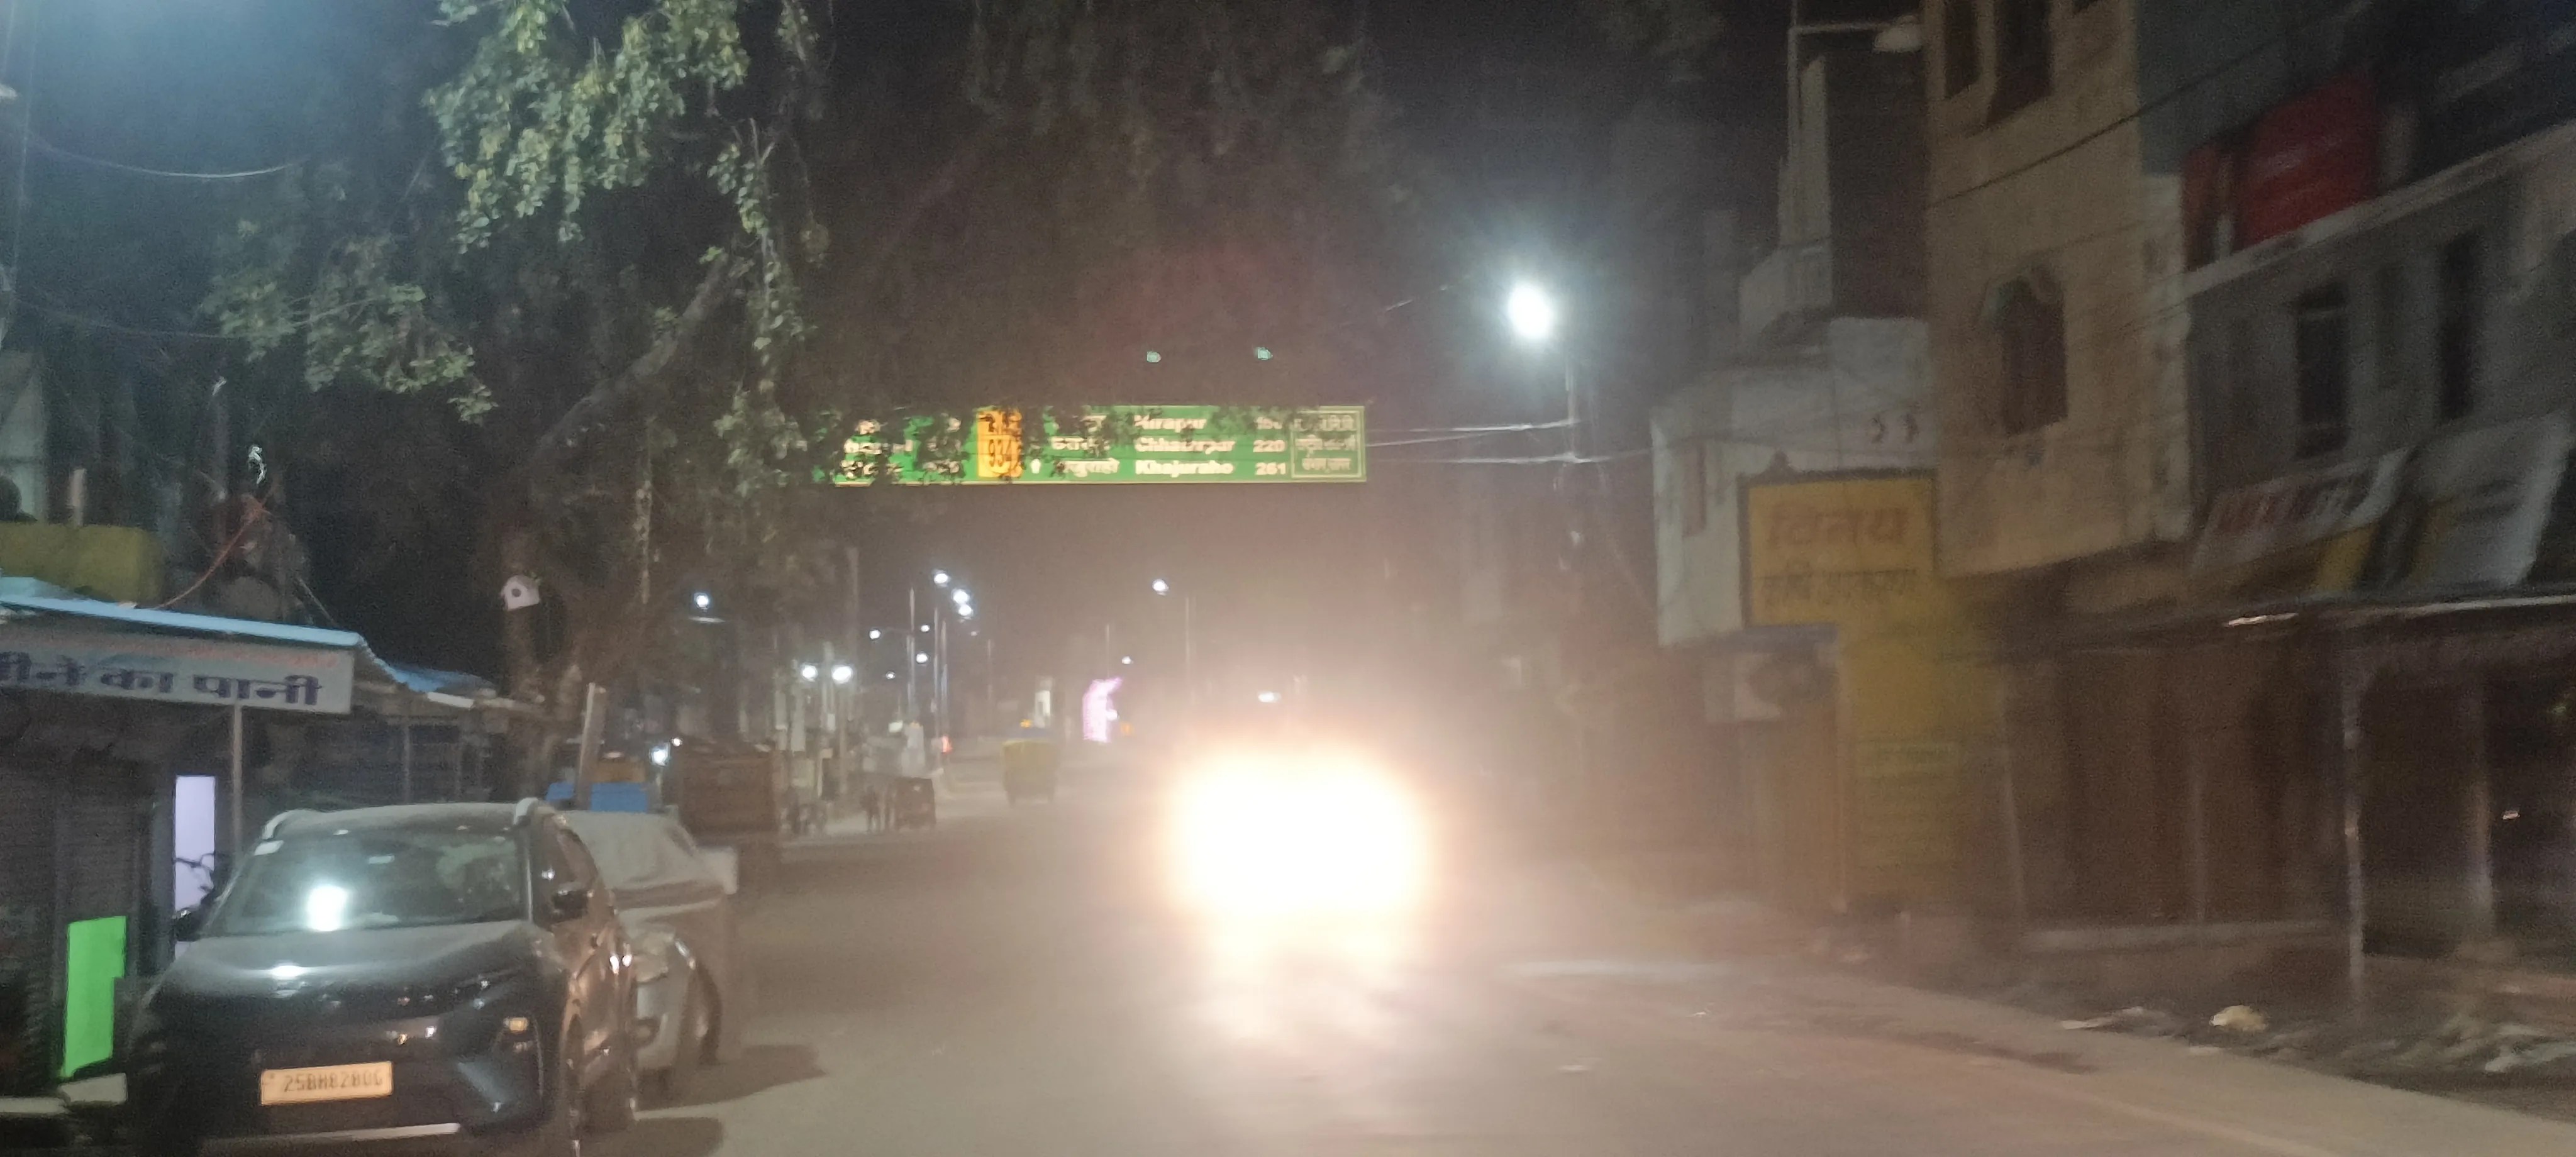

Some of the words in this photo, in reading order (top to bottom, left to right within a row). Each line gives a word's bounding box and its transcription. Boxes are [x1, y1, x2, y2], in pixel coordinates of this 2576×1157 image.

[1253, 440, 1286, 452] 220
[1135, 460, 1235, 478] Khajuraho
[192, 673, 323, 706] पानी
